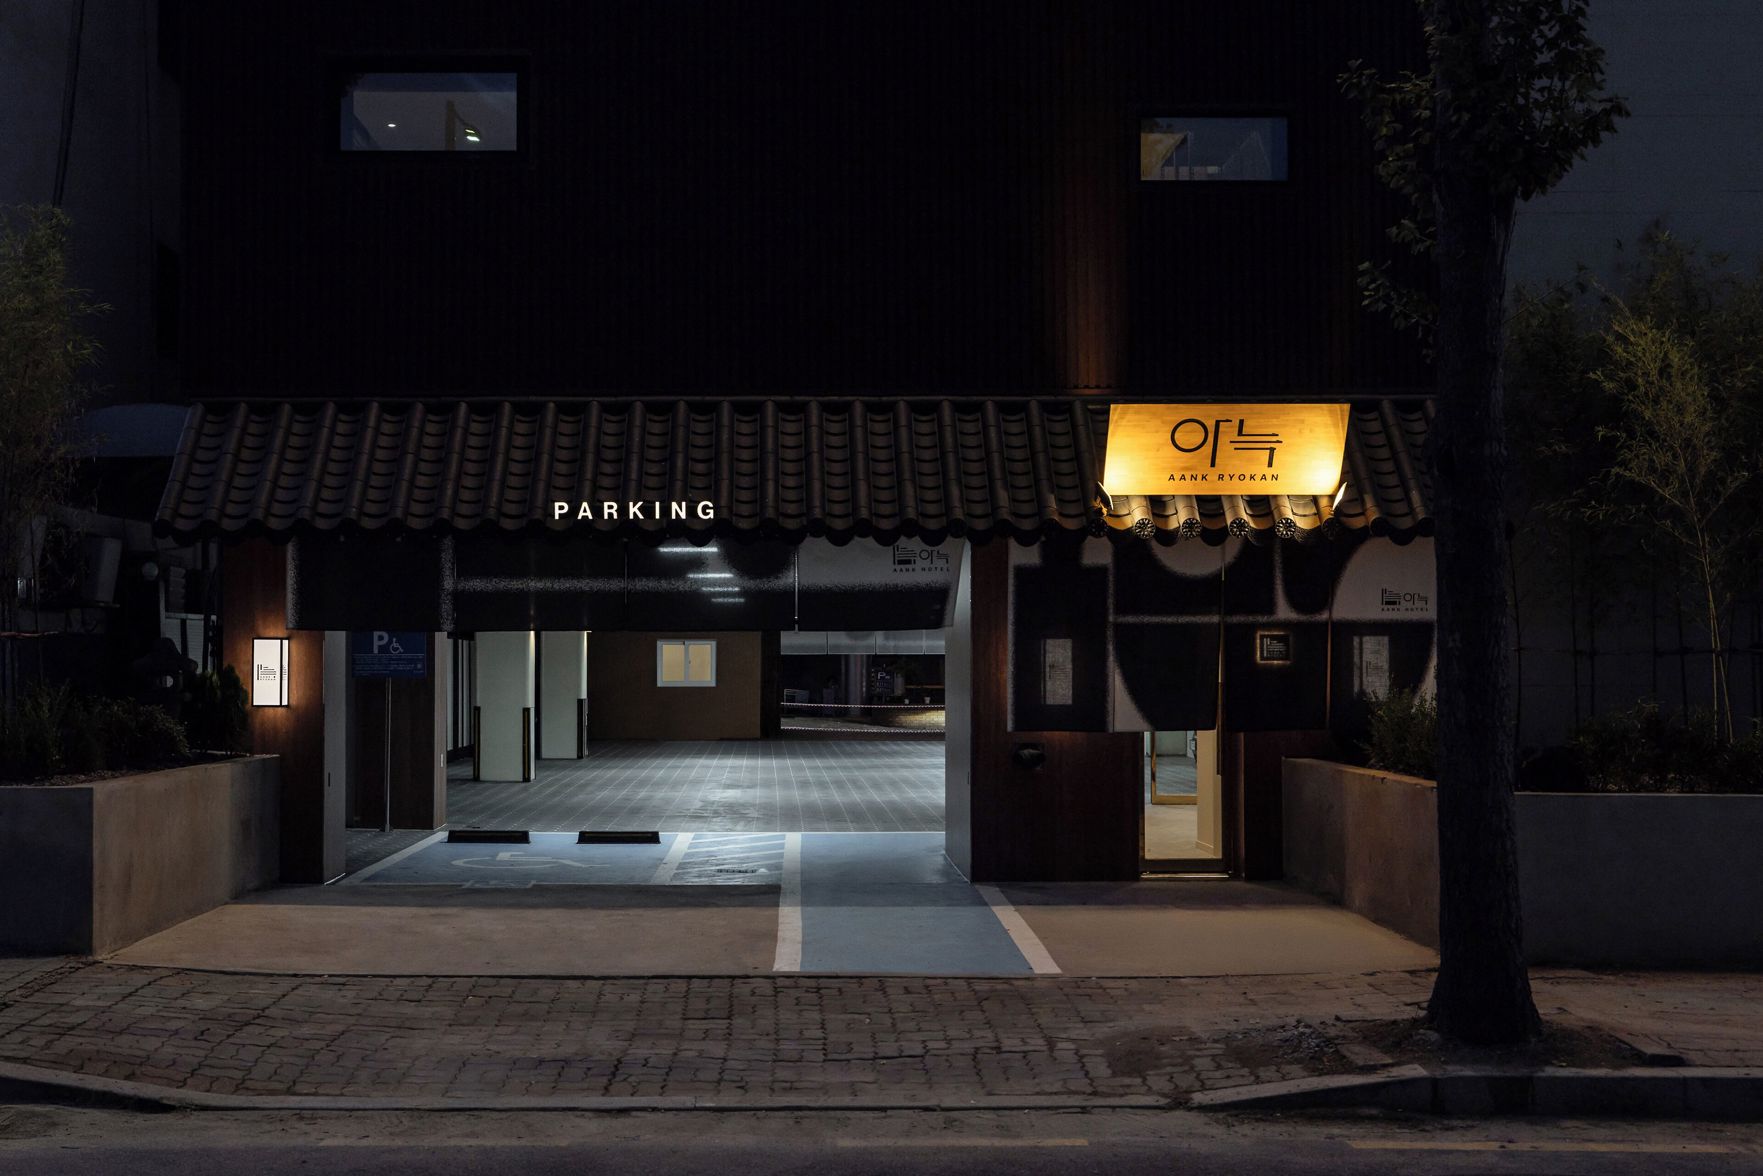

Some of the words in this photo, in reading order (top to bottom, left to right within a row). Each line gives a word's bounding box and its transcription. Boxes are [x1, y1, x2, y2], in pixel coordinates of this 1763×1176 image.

[1170, 418, 1283, 468] 아늑
[1168, 473, 1209, 482] AANK
[1217, 473, 1279, 482] RYOKAN
[554, 501, 715, 520] PARKING
[372, 631, 390, 654] P
